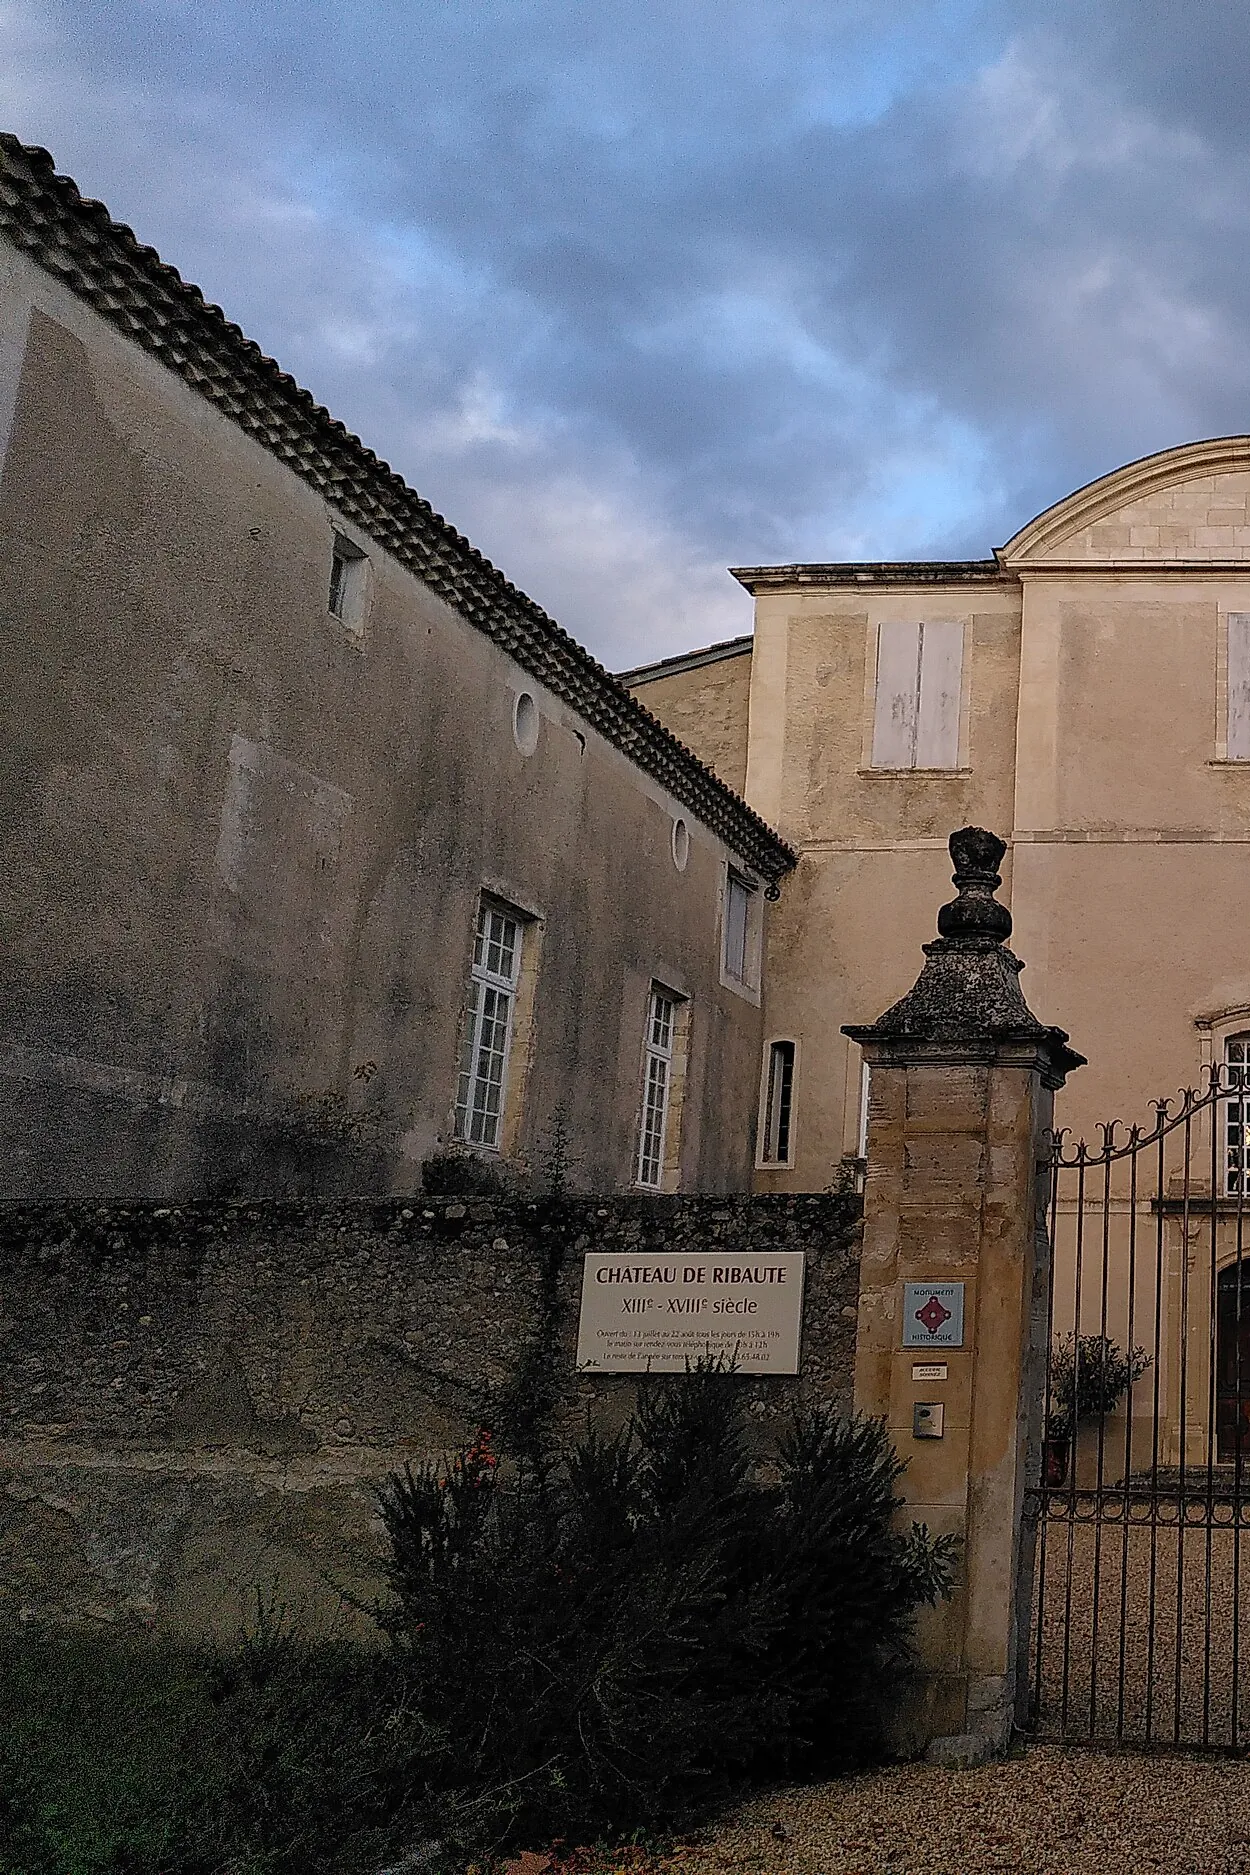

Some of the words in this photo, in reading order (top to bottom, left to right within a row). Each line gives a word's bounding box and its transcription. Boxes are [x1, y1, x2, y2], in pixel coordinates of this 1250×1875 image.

[596, 1266, 677, 1284] CHÂTEAU
[683, 1267, 706, 1284] DE
[712, 1267, 787, 1284] RIBAUTE
[913, 1289, 954, 1297] MONUMENT
[713, 1297, 758, 1314] siècle
[642, 1329, 660, 1339] juillet
[711, 1330, 720, 1338] les
[720, 1330, 736, 1339] jours
[737, 1330, 746, 1338] de
[912, 1334, 952, 1342] HISTORIQUE
